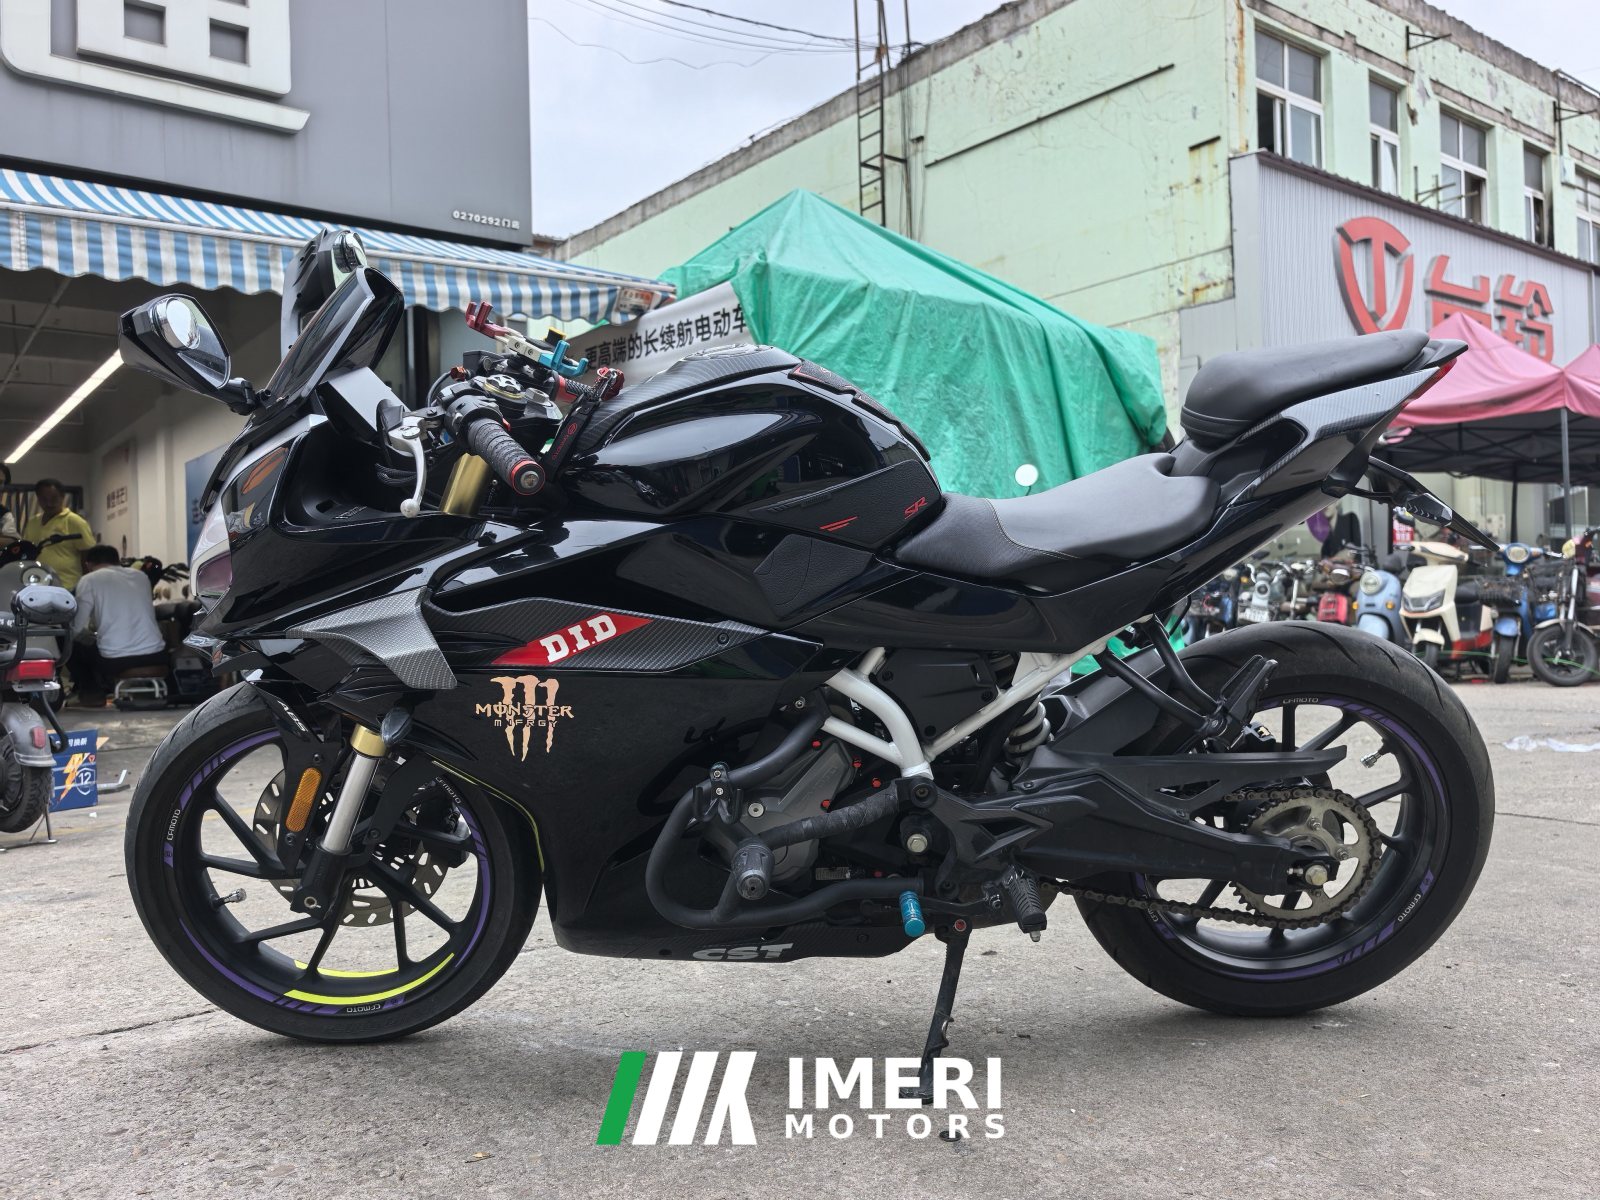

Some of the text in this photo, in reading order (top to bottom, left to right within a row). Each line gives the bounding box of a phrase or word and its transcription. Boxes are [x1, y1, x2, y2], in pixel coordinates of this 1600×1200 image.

[475, 701, 574, 719] MONSTER
[77, 772, 92, 785] 12
[166, 809, 181, 841] CFMOTO
[1397, 893, 1422, 922] CFMOTO
[692, 943, 794, 960] CST
[346, 1003, 381, 1013] CFMOTO
